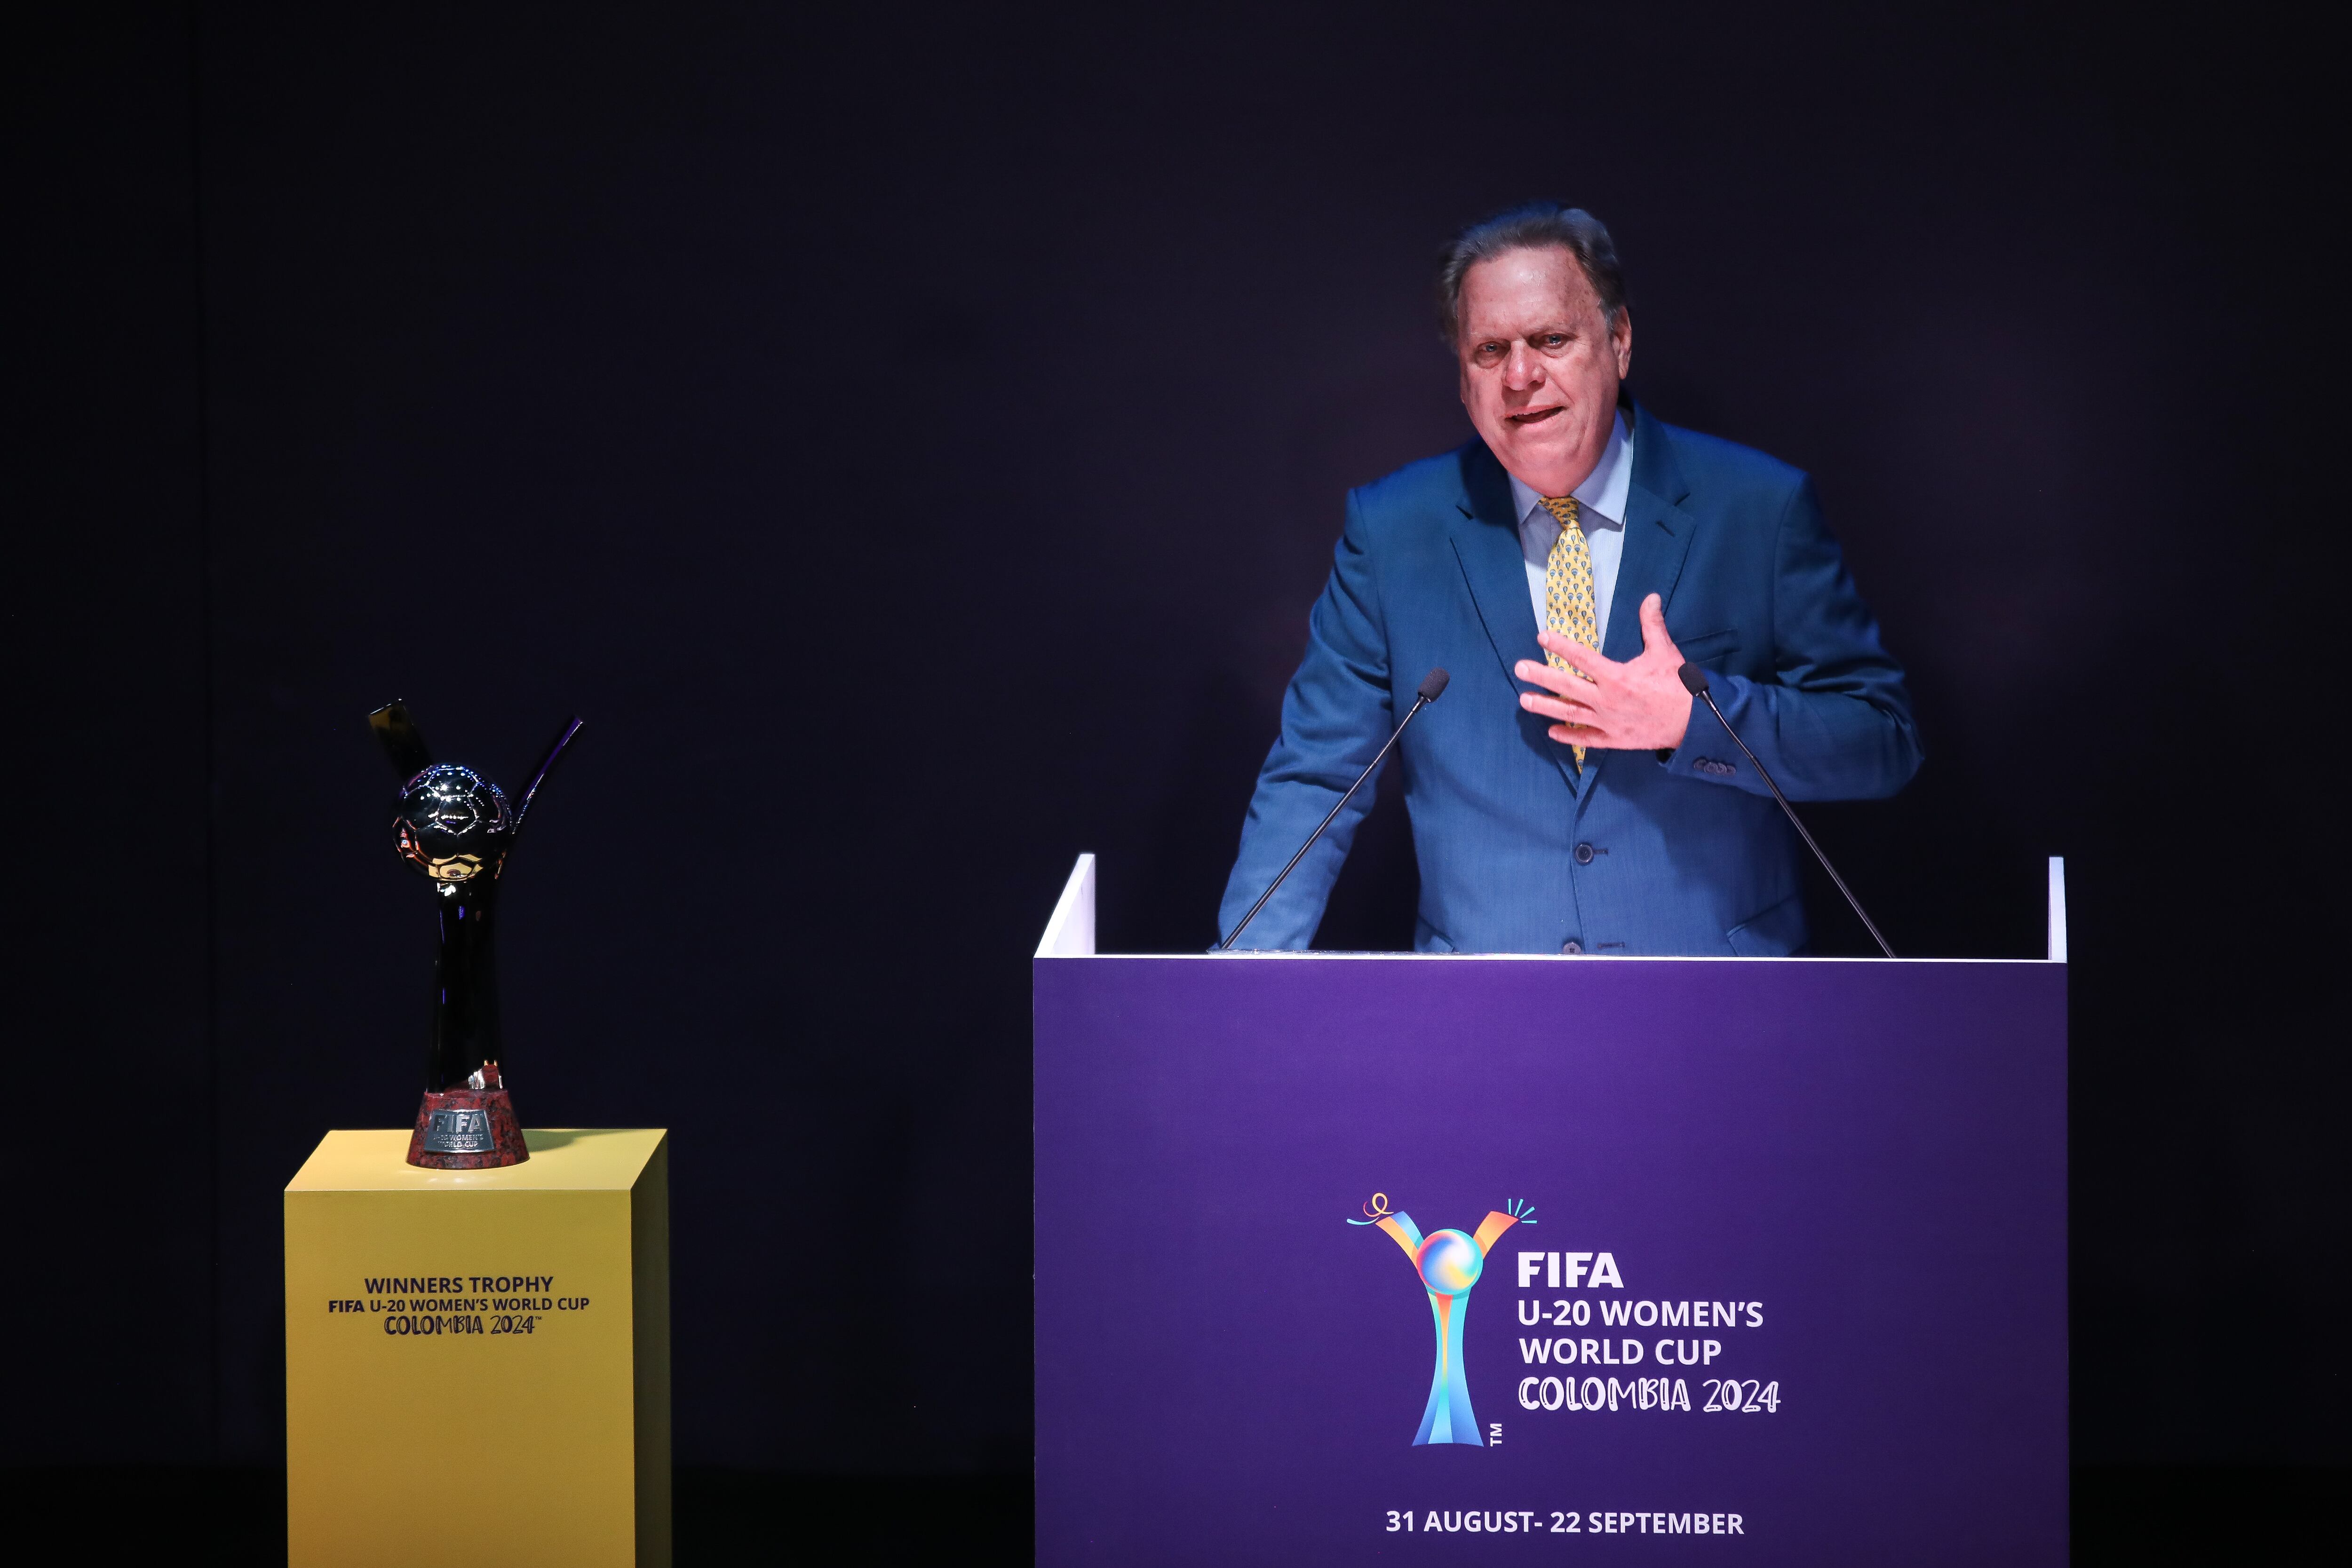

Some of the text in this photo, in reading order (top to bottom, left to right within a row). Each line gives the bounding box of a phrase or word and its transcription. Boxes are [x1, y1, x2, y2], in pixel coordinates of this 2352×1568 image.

[433, 1113, 484, 1132] FIFA
[1518, 1251, 1624, 1289] FIFA
[364, 1276, 554, 1294] WINNERS TROPHY
[328, 1297, 590, 1313] FIFA U-20 WOMEN’S WORLD CUP
[1518, 1300, 1764, 1328] U-20 WOMEN’S
[383, 1315, 484, 1336] COLOMBIA
[1518, 1338, 1722, 1365] WORLD CUP
[1518, 1376, 1781, 1413] COLOMBIA 2024
[1386, 1511, 1745, 1535] 31 AUGUST- 22 SEPTEMBER
